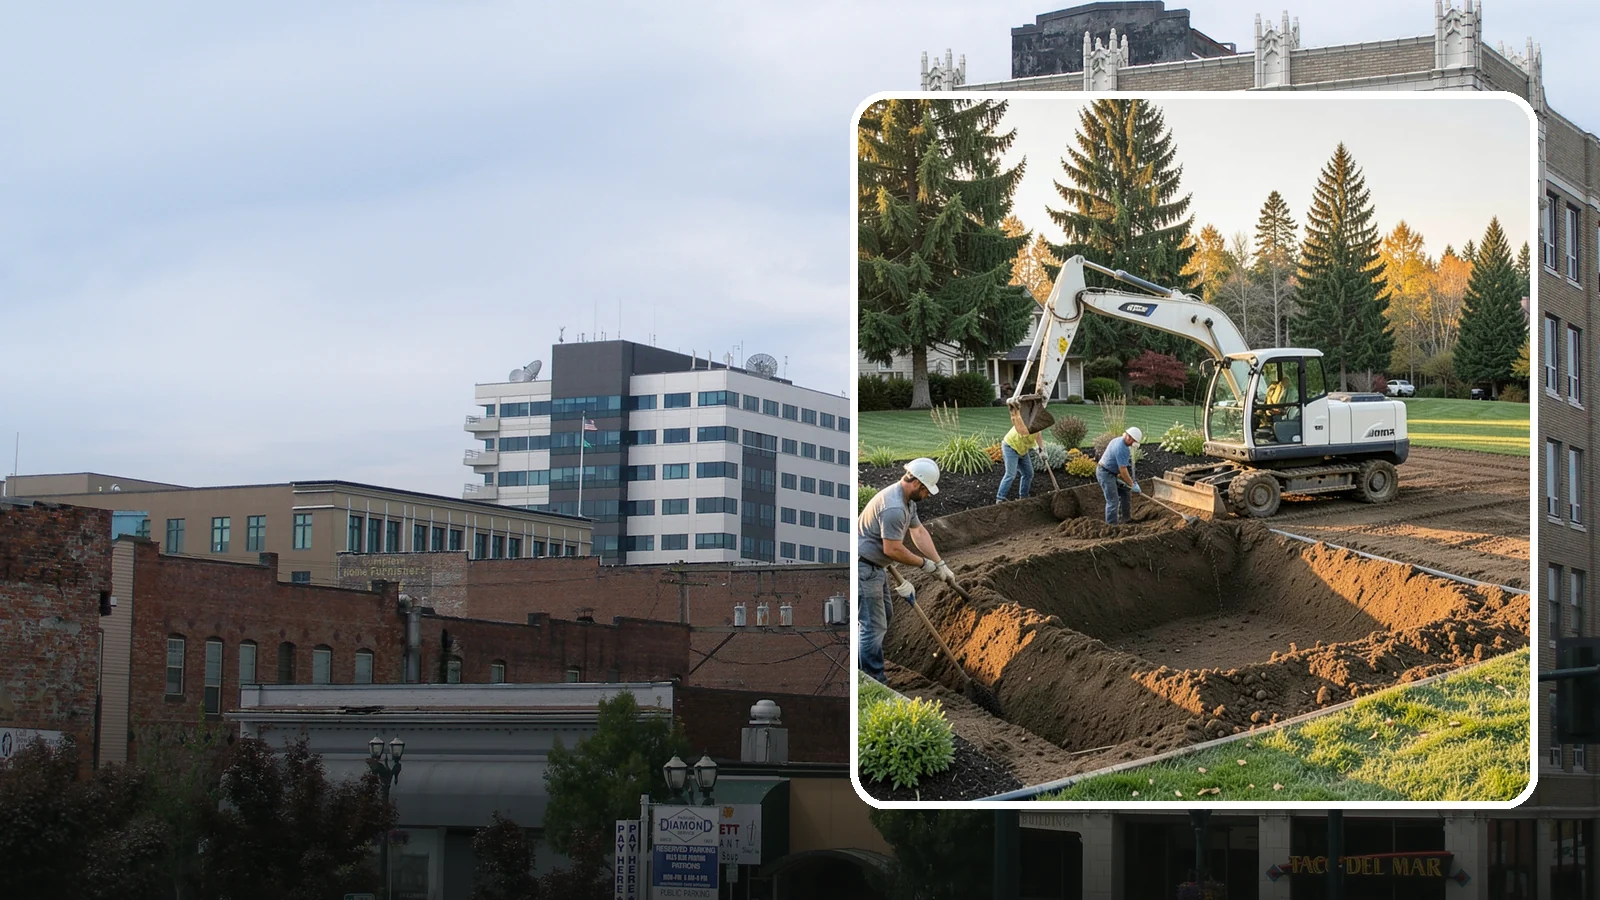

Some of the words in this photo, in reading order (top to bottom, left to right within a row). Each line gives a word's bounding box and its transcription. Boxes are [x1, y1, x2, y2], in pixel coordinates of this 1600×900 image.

[343, 568, 367, 577] Home
[370, 566, 427, 577] Furnishers
[660, 818, 713, 833] DIAMOND
[1022, 815, 1070, 828] BUILDING
[617, 825, 625, 852] PAY
[628, 825, 637, 852] PAY
[656, 845, 688, 853] RESERVED
[689, 846, 716, 854] PARKING
[722, 851, 738, 862] Soup
[671, 862, 701, 870] PATRONS
[1346, 856, 1385, 876] DEL
[1392, 857, 1442, 877] MAR
[616, 856, 625, 893] HERE
[627, 856, 636, 893] HERE
[660, 889, 682, 897] PUBLIC
[684, 890, 710, 898] PARKING
